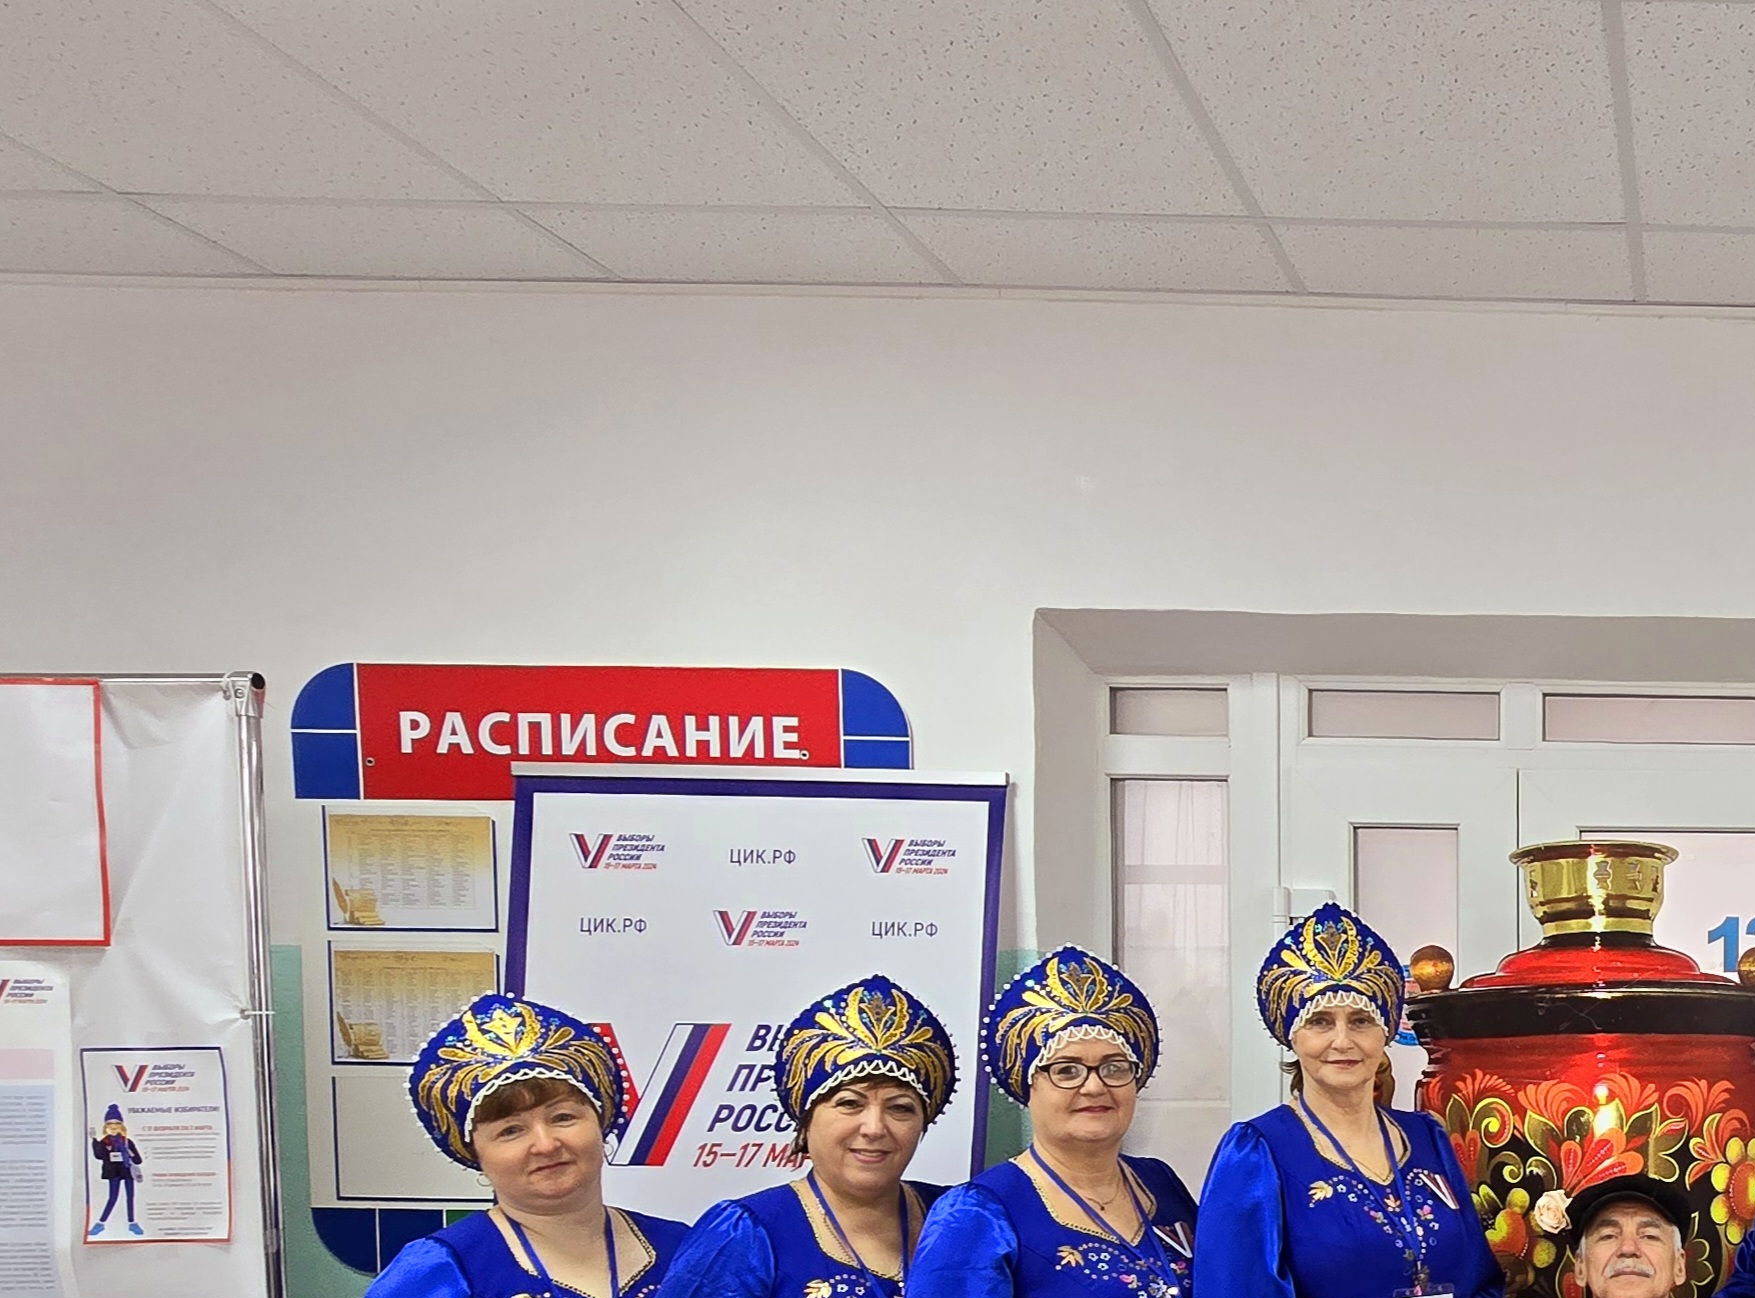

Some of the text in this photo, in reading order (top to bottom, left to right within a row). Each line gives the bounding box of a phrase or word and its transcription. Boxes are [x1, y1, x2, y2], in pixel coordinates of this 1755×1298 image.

[399, 711, 799, 758] РАСПИСАНИЕ
[616, 834, 655, 842] ВЫБОРЫ
[612, 844, 666, 852] ПРЕЗИДЕНТА
[607, 853, 642, 861] РОССИИ
[903, 849, 956, 857] ПРЕЗИДЕНТА
[730, 849, 796, 866] ЦИК.РФ
[899, 858, 933, 866] РОССИИ
[760, 911, 797, 919] ВЫБОРЫ
[580, 917, 647, 935] ЦИК.РФ
[756, 921, 807, 929] ПРЕЗИДЕНТА
[751, 930, 785, 938] РОССИИ
[872, 921, 938, 939] ЦИК.РФ
[707, 1104, 793, 1132] РОСС
